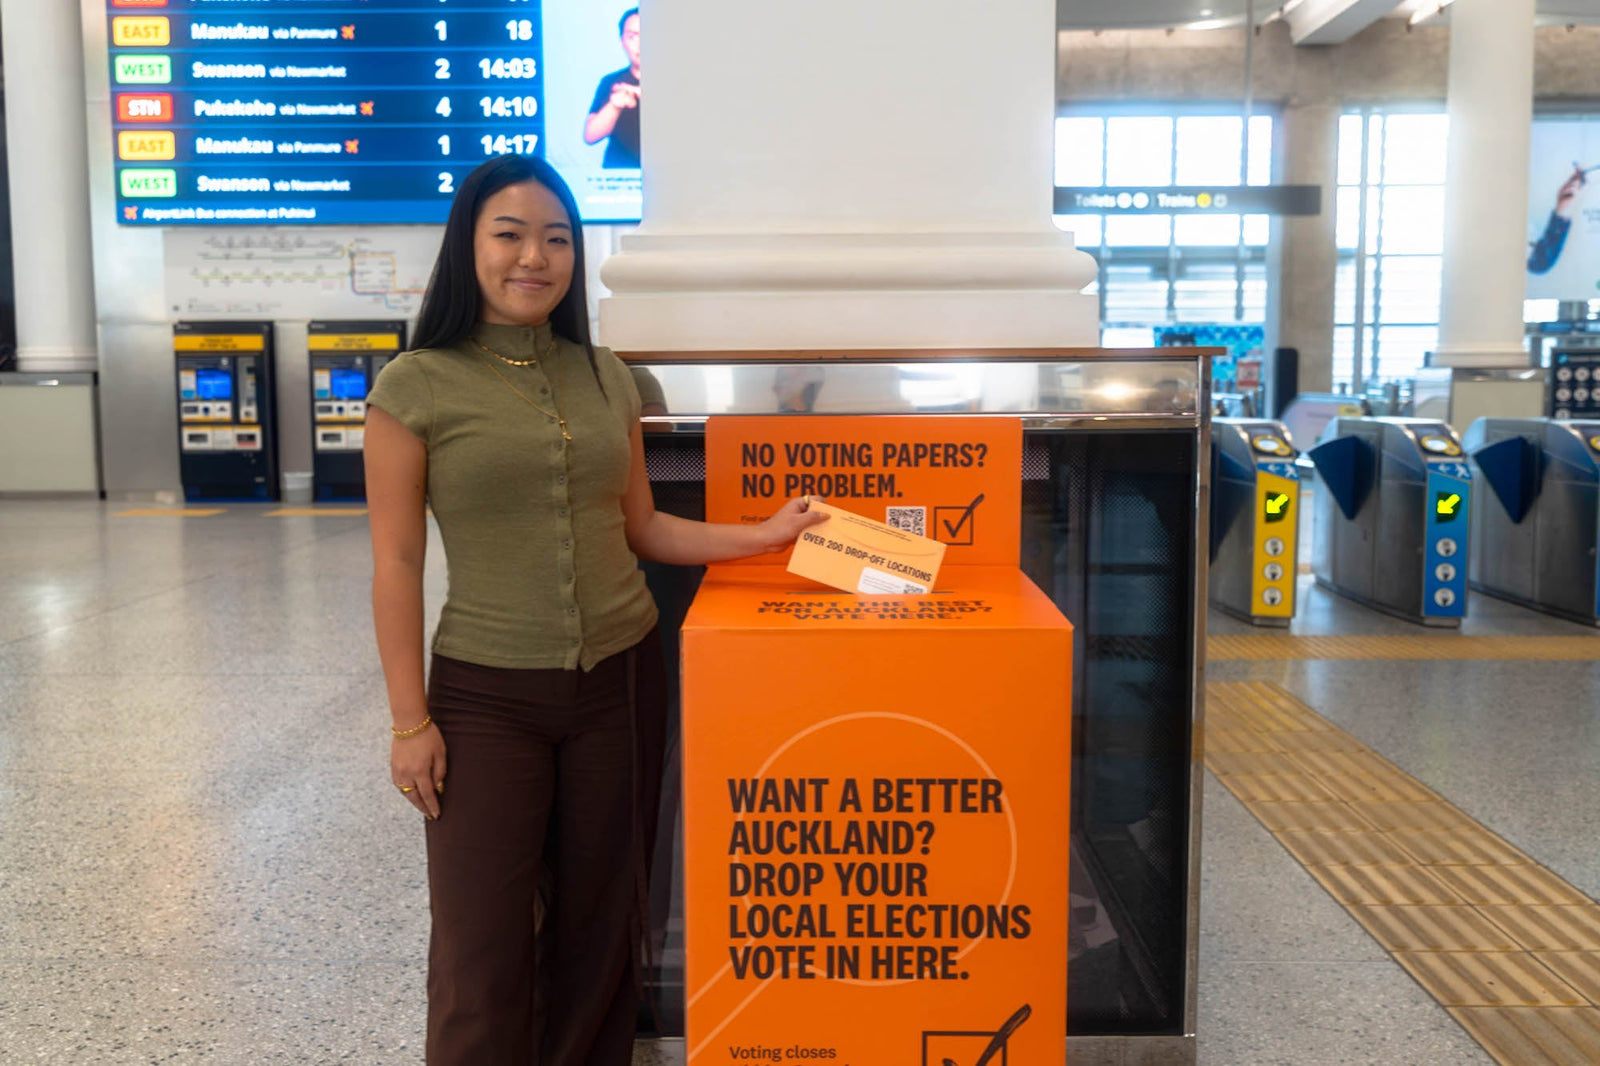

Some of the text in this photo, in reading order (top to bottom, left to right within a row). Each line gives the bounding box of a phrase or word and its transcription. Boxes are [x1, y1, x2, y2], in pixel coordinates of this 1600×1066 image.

[122, 25, 161, 39] EAST
[434, 20, 447, 41] 1
[506, 19, 533, 41] 18
[121, 64, 164, 76] WEST
[192, 61, 266, 78] Swanson
[435, 58, 451, 79] 2
[479, 57, 537, 79] 14:03
[127, 99, 162, 116] STH
[435, 96, 452, 117] 4
[479, 96, 538, 117] 14:10
[127, 139, 166, 153] EAST
[437, 134, 450, 155] 1
[480, 134, 538, 155] 14:17
[127, 178, 169, 190] WEST
[197, 175, 270, 192] Swanson
[438, 172, 454, 193] 2
[741, 442, 988, 468] NO VOTING PAPERS?
[741, 473, 904, 499] NO PROBLEM.
[803, 532, 932, 582] OVER 200 DROP-OFF LOCATIONS
[727, 778, 1004, 814] WANT A BETTER
[728, 819, 936, 856] AUCKLAND?
[729, 861, 928, 898] DROP YOUR
[729, 903, 1032, 940] LOCAL ELECTIONS
[728, 945, 970, 980] VOTE IN HERE.
[729, 1045, 837, 1062] Voting closes
